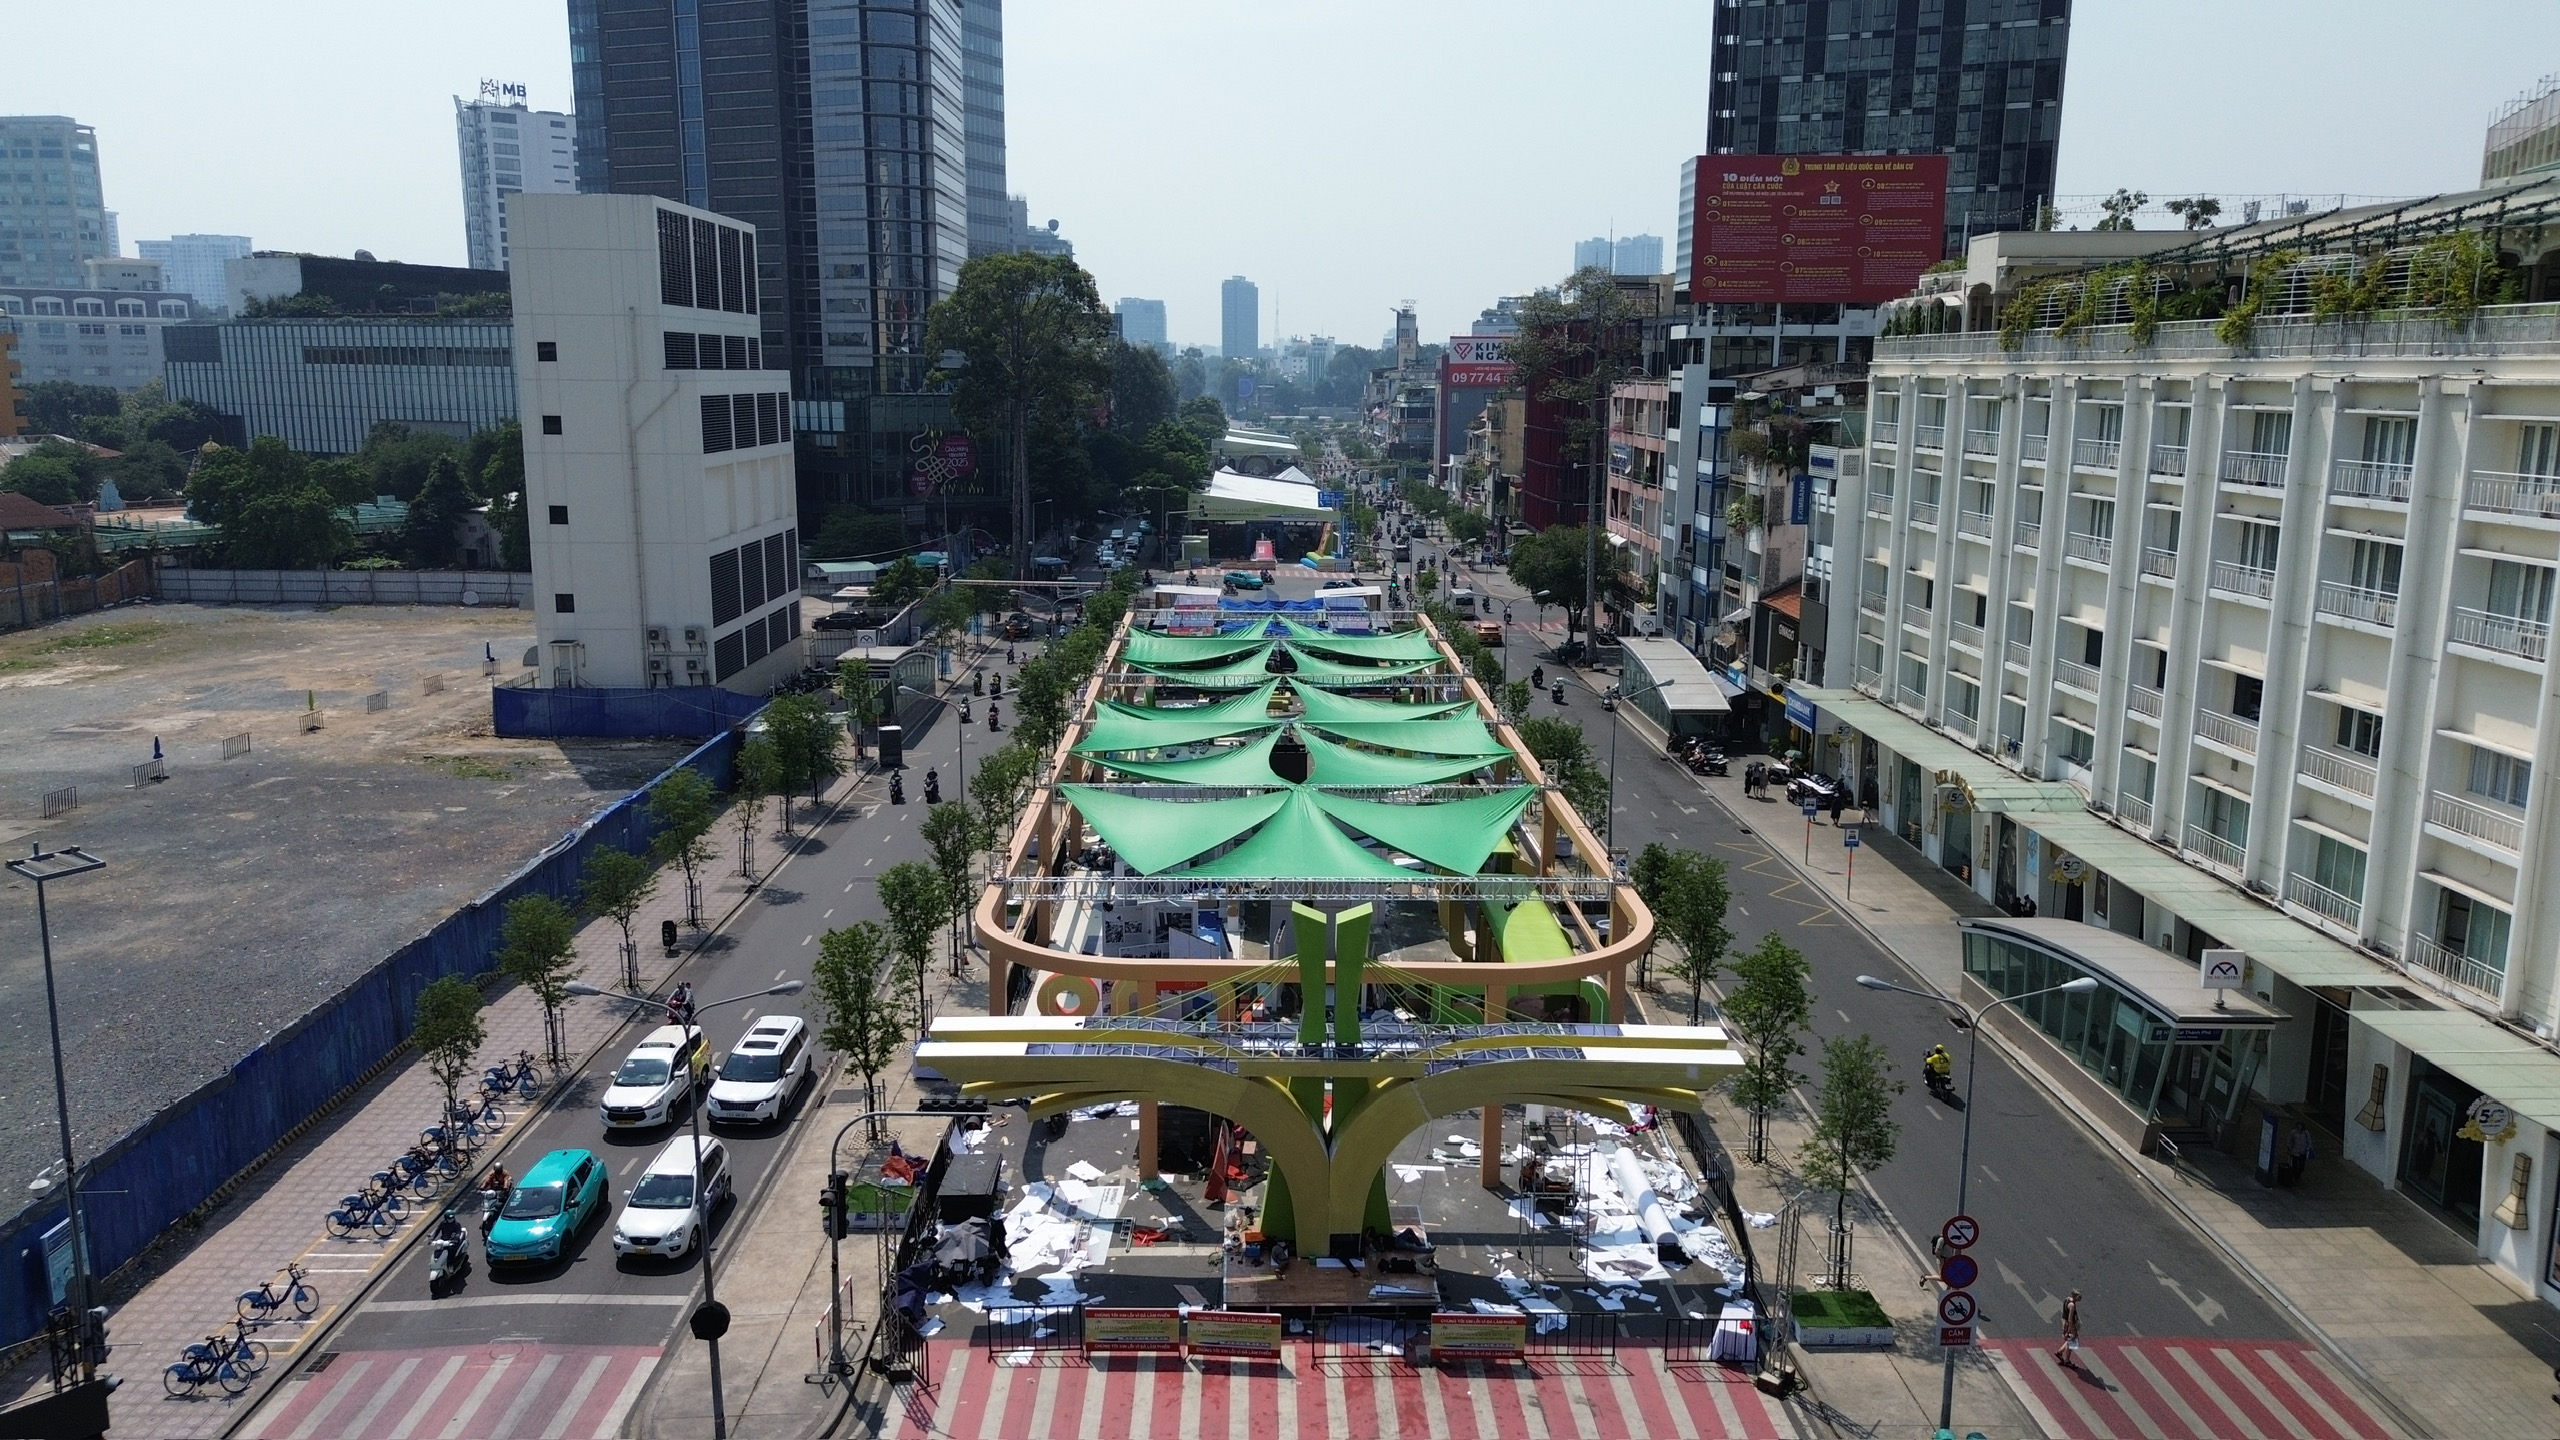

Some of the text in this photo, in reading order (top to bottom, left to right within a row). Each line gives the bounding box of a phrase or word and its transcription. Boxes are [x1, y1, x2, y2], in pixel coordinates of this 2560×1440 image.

[502, 83, 527, 97] MB
[1722, 173, 1738, 182] 10
[1476, 342, 1501, 351] KIM
[1476, 352, 1511, 360] NGA
[1452, 373, 1468, 383] 09
[1470, 373, 1484, 382] 77
[1486, 373, 1501, 382] 44
[947, 458, 968, 467] 2025
[1798, 481, 1806, 520] EXIMBANK
[1788, 696, 1811, 717] EXIMBANK
